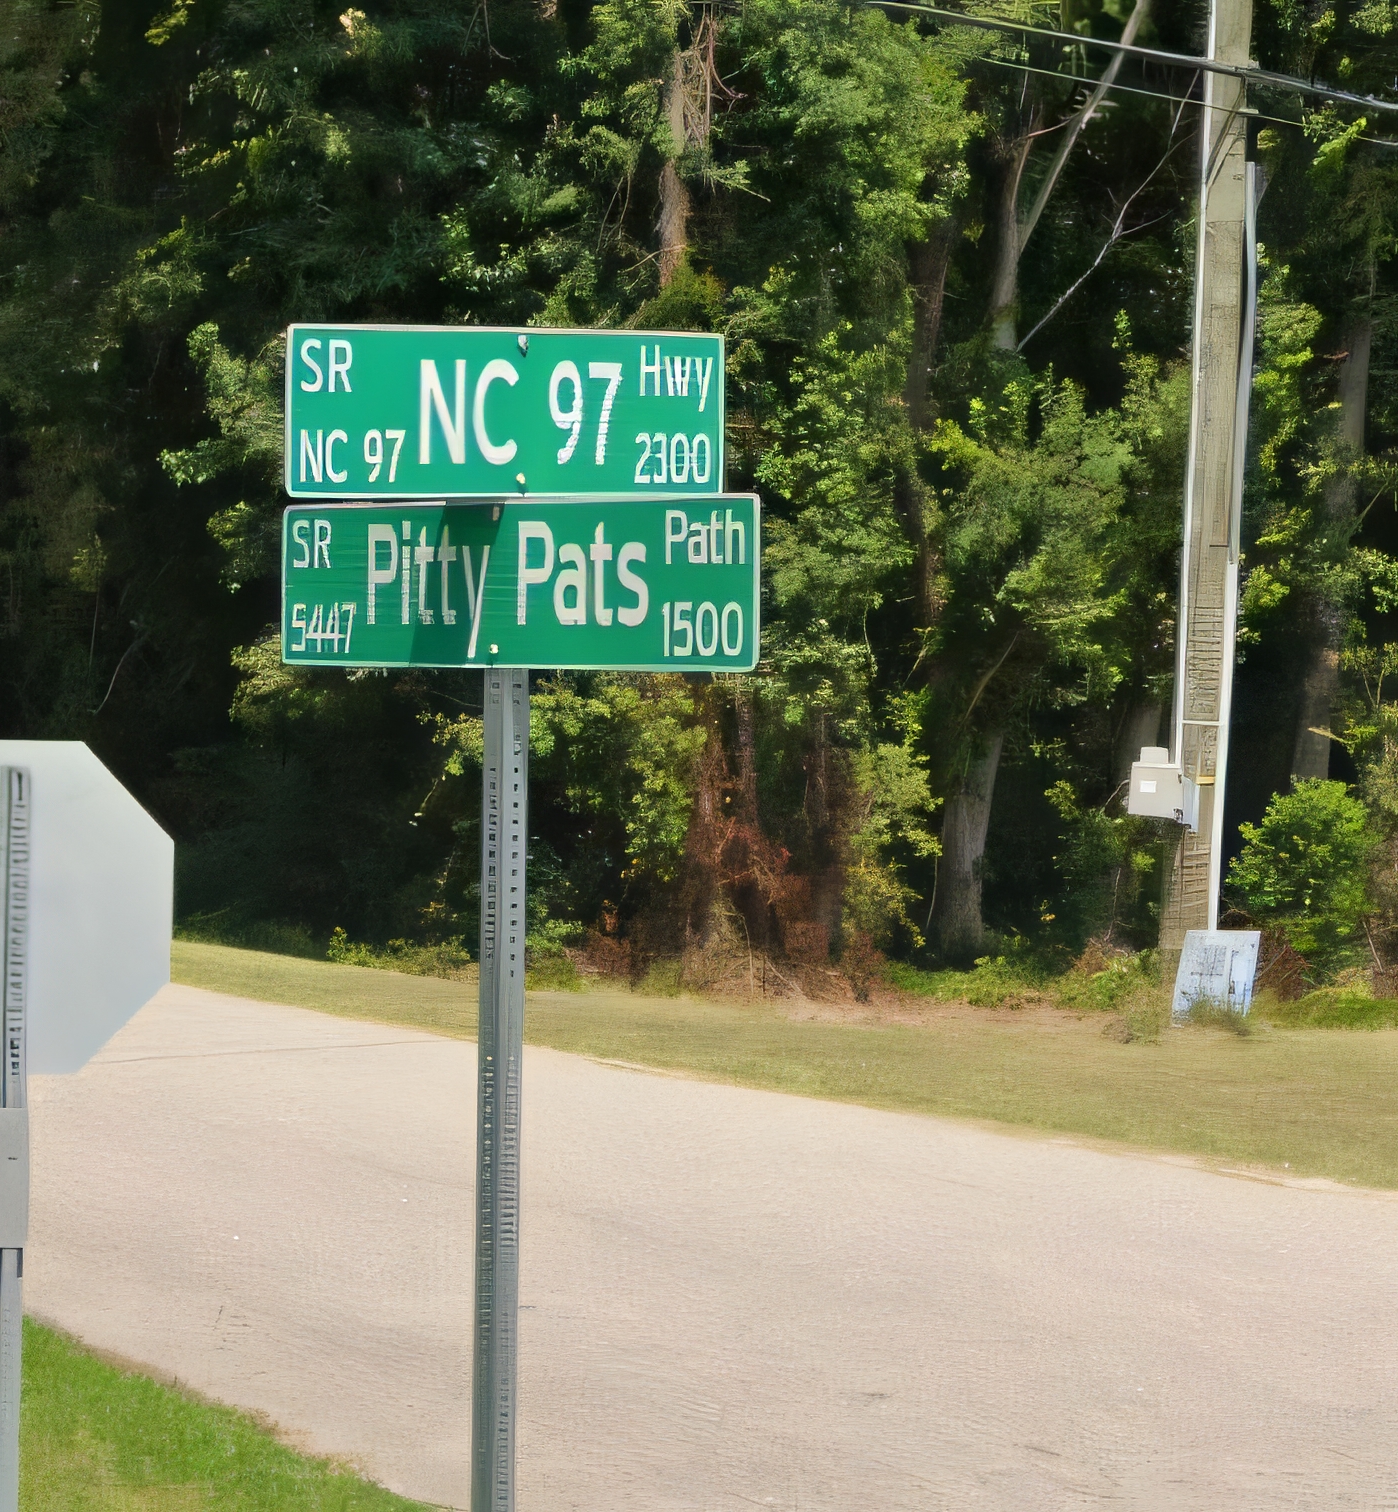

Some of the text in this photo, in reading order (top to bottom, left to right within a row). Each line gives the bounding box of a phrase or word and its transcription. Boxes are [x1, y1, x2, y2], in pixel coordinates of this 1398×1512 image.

[300, 338, 352, 392] SR
[639, 344, 713, 412] Hwy
[419, 358, 623, 465] NC 97
[300, 429, 406, 483] NC 97
[634, 432, 711, 483] 2300
[292, 519, 332, 568] SR
[665, 509, 745, 564] Path
[367, 520, 649, 658] Pitty Pats
[291, 602, 357, 653] 5447
[662, 601, 744, 657] 1500
